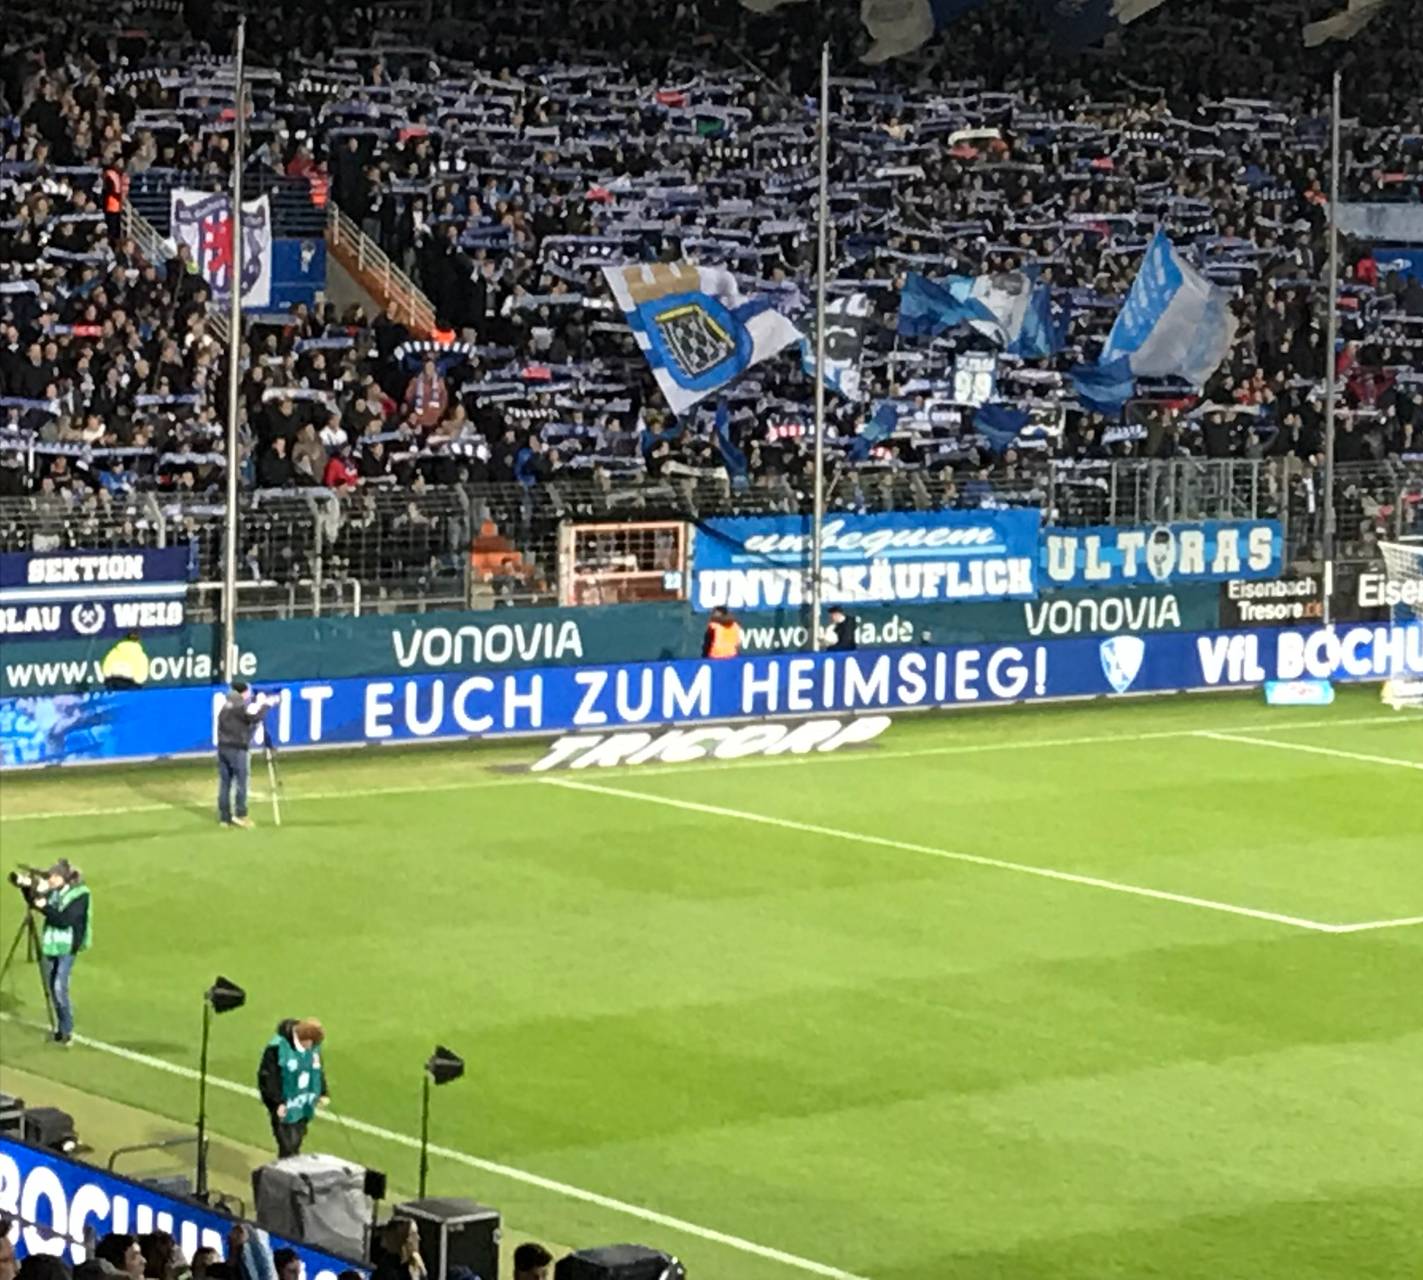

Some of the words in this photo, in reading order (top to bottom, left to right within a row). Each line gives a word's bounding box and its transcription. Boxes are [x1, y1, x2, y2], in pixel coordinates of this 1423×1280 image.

[744, 519, 995, 559] unbequem
[28, 554, 144, 584] SEKTION
[699, 557, 1033, 607] UNVERKÄUFLICH
[1227, 577, 1318, 599] Eisenbach
[740, 614, 914, 651] ww.voia.de
[6, 644, 258, 689] www.vovia.de
[1198, 632, 1266, 684] VfL
[365, 674, 542, 739] EUCH
[573, 664, 712, 726] ZUM
[742, 646, 1048, 715] HEIMSIEG!
[531, 716, 892, 772] TRICORP
